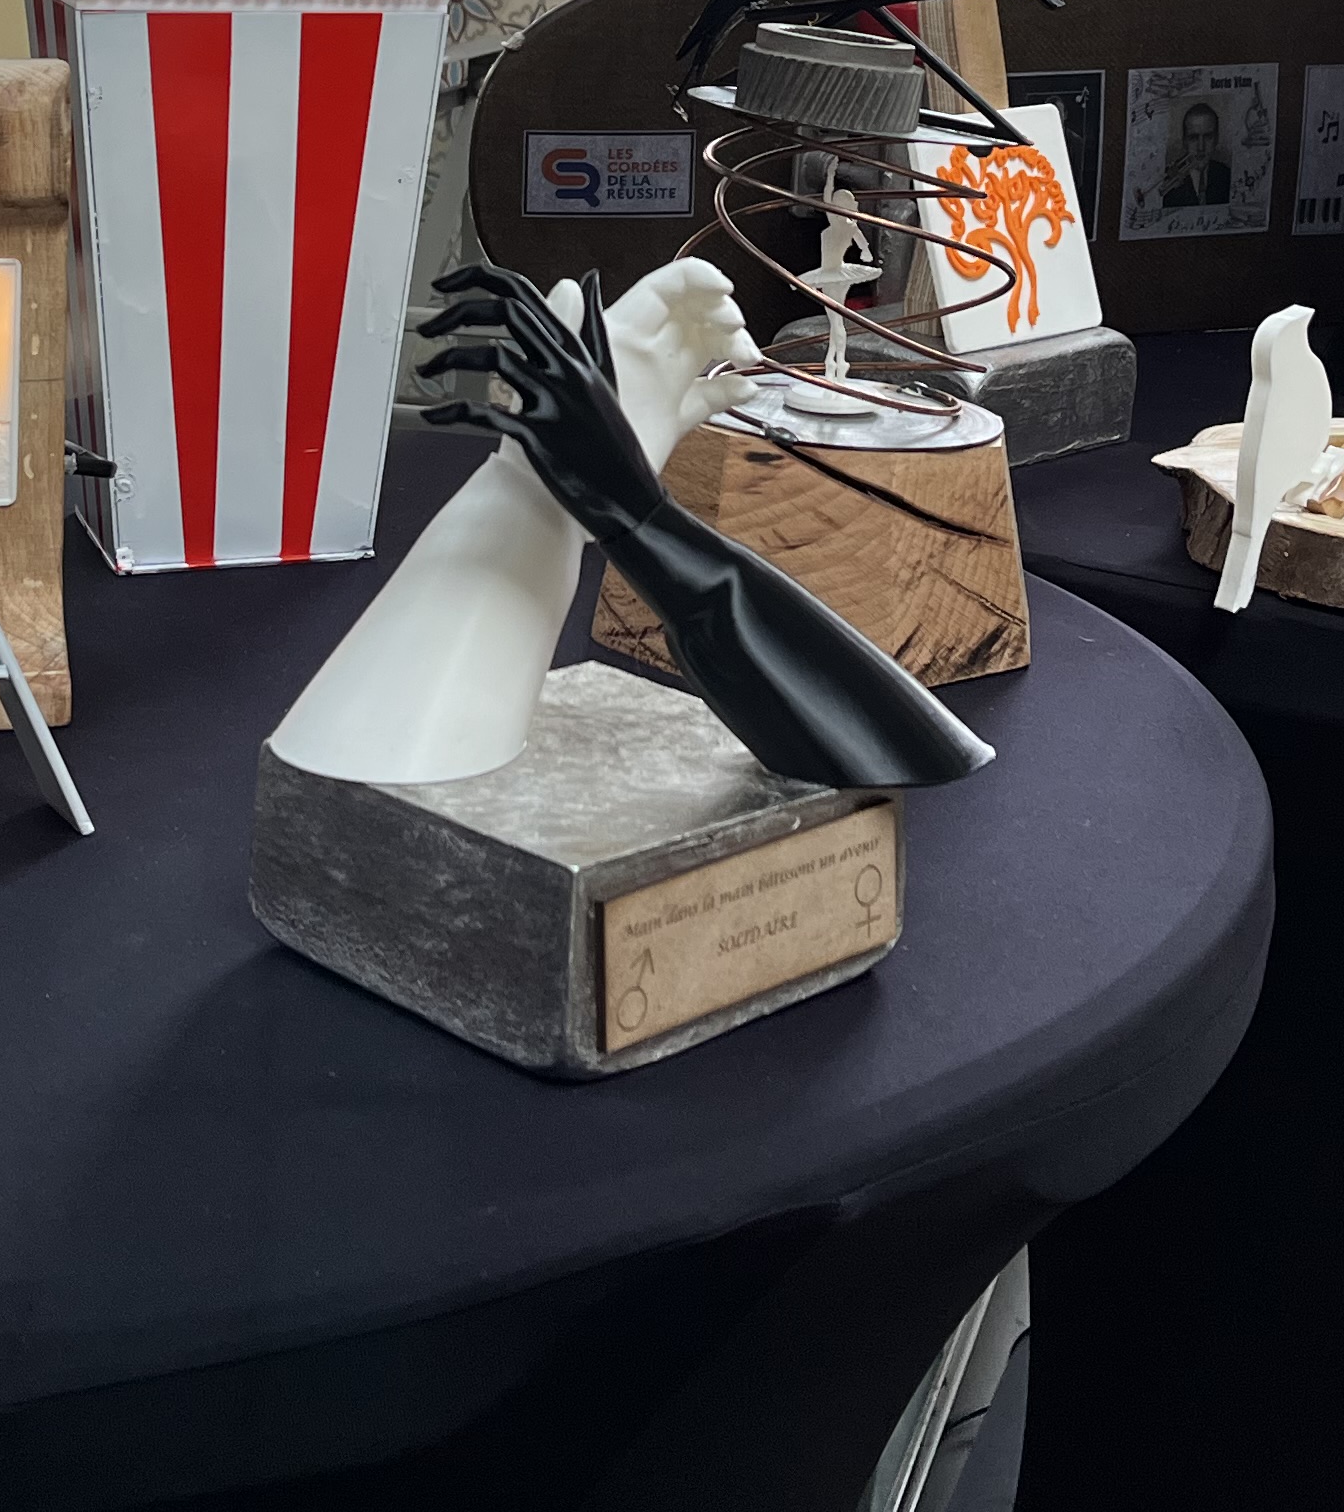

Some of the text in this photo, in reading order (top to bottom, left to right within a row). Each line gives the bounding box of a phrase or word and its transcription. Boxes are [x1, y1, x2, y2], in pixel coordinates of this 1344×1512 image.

[608, 148, 633, 160] LES
[607, 160, 678, 173] CORDÉES
[607, 175, 651, 186] DE LA
